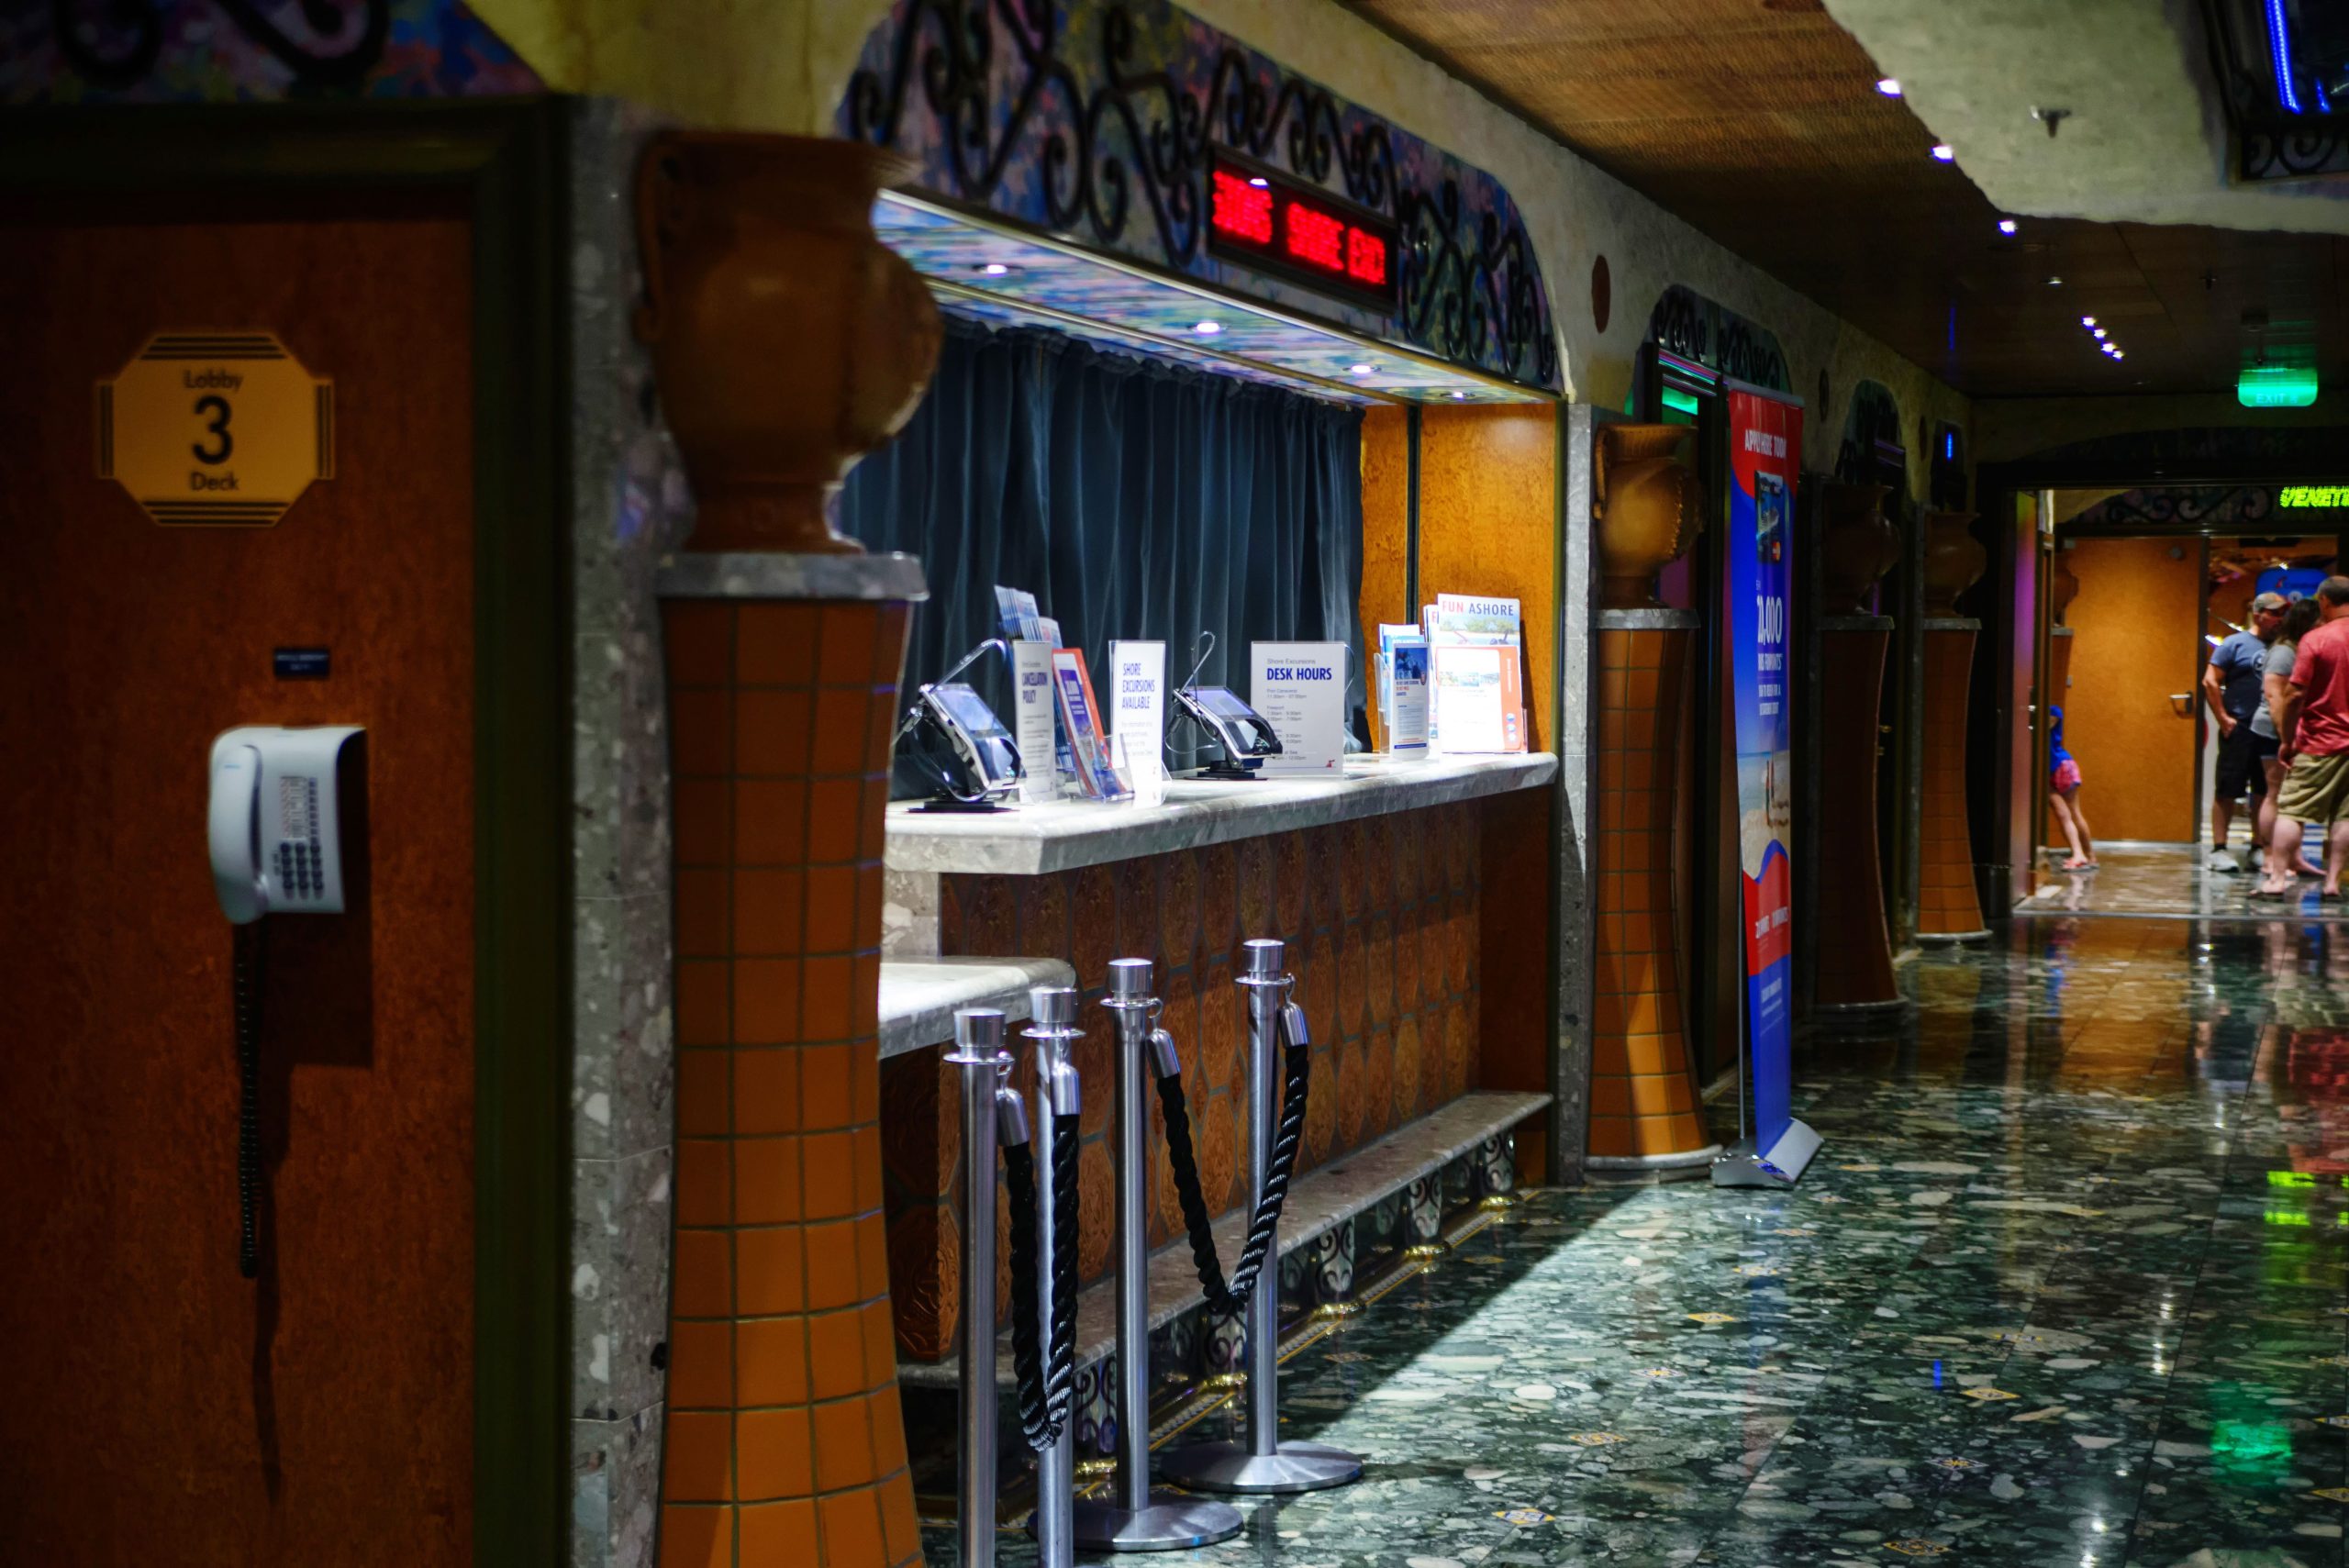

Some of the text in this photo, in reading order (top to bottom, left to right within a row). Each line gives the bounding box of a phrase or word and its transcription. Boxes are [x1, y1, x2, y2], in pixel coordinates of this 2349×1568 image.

[184, 369, 244, 392] Lobby
[2256, 393, 2286, 404] EXIT
[193, 396, 233, 465] 3
[190, 470, 239, 492] Deck
[1442, 600, 1514, 617] FUN ASHORE
[1123, 662, 1141, 676] SHORE
[1267, 668, 1332, 680] DESK HOURS
[1122, 679, 1155, 693] EXCURSIONS
[1122, 696, 1150, 710] AVAILABLE
